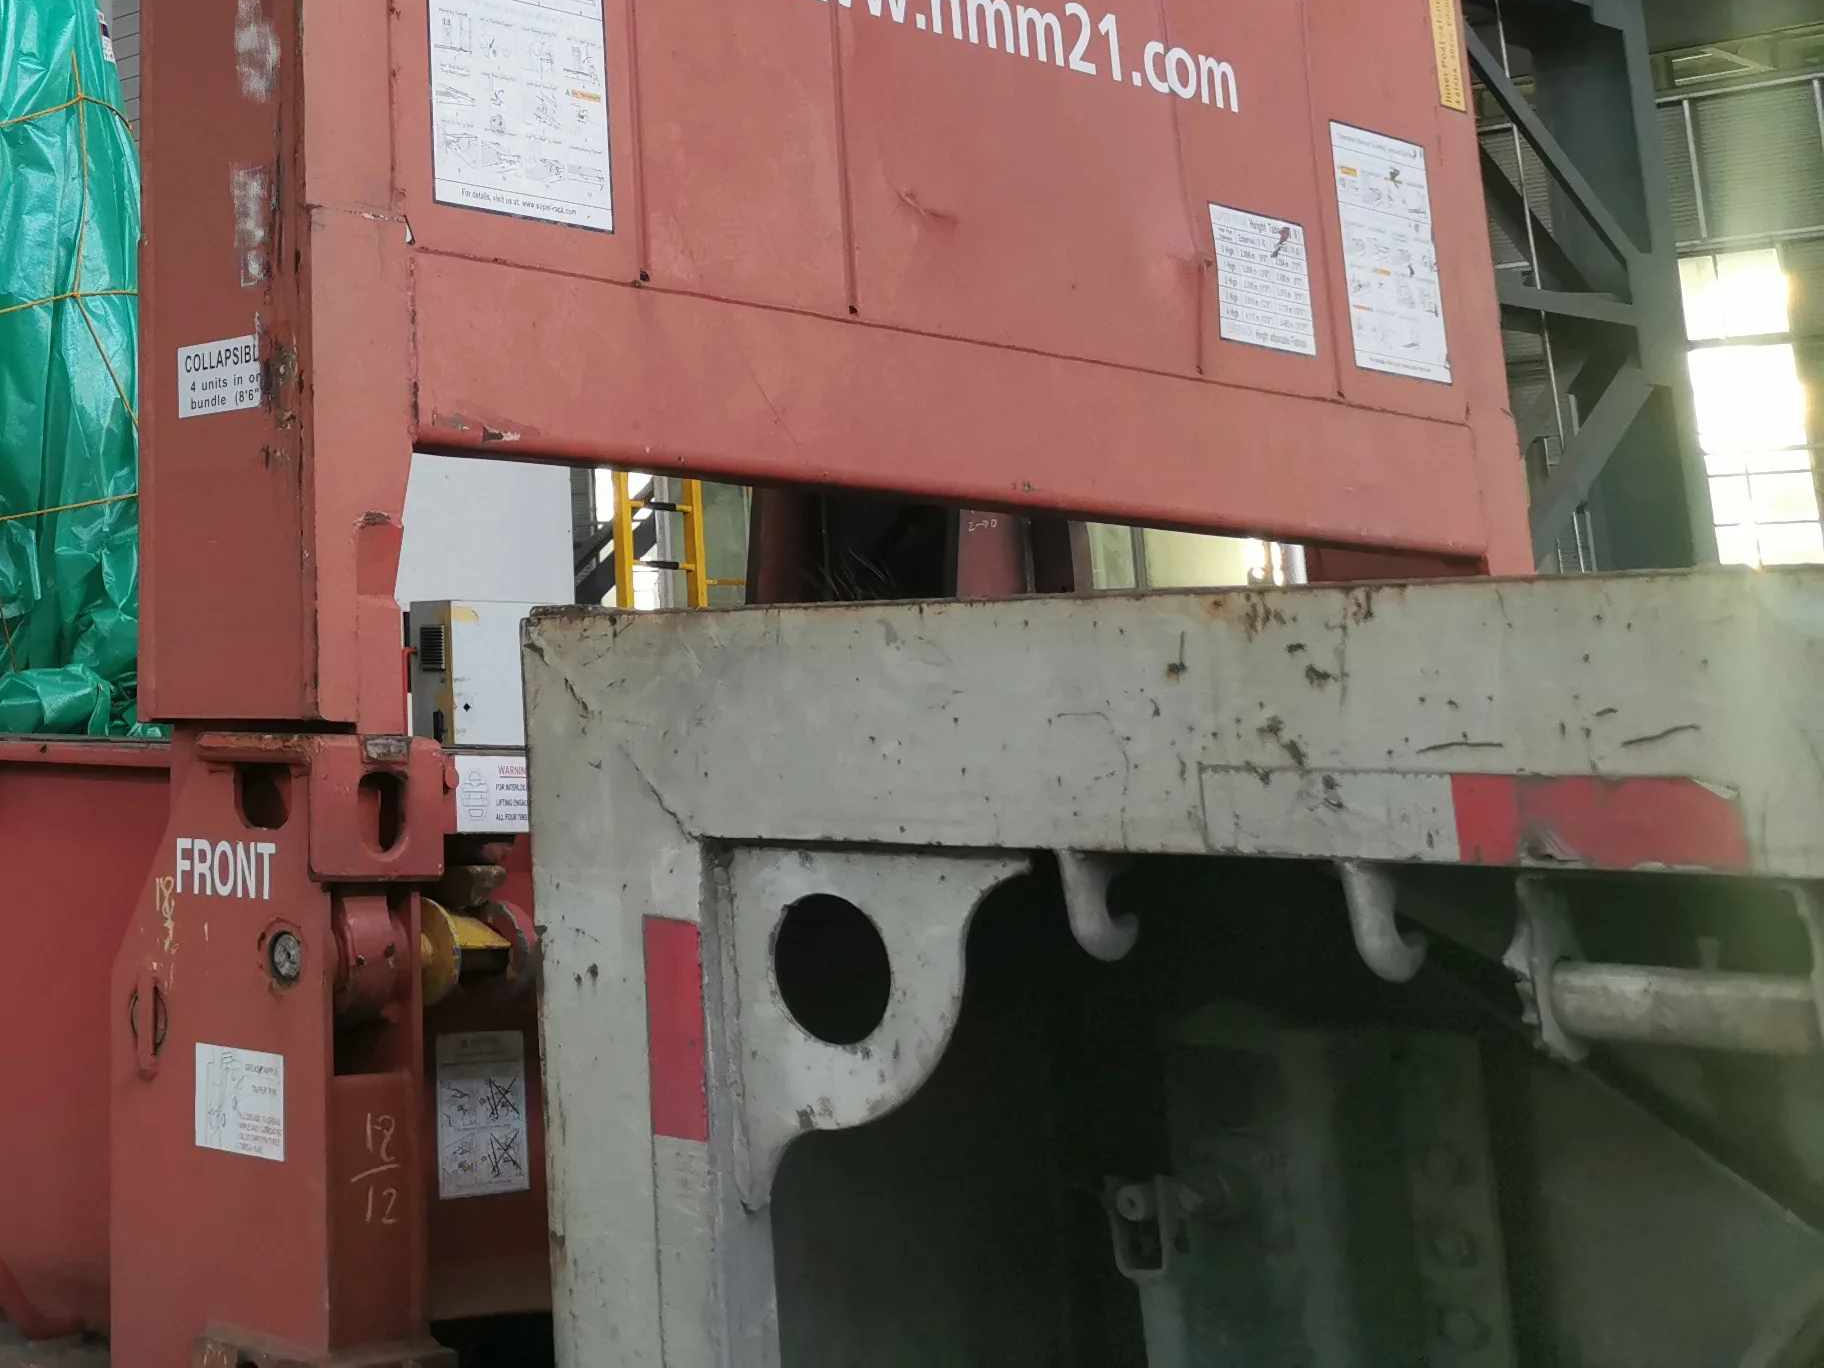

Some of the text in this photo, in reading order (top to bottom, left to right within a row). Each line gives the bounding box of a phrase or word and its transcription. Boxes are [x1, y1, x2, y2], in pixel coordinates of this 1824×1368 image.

[461, 187, 472, 198] For
[190, 381, 196, 392] 4
[201, 377, 228, 391] units
[233, 374, 243, 386] in
[190, 394, 227, 410] bundle
[498, 765, 527, 775] WARNIN
[506, 783, 528, 791] INTERLOC
[176, 837, 275, 900] FRONT
